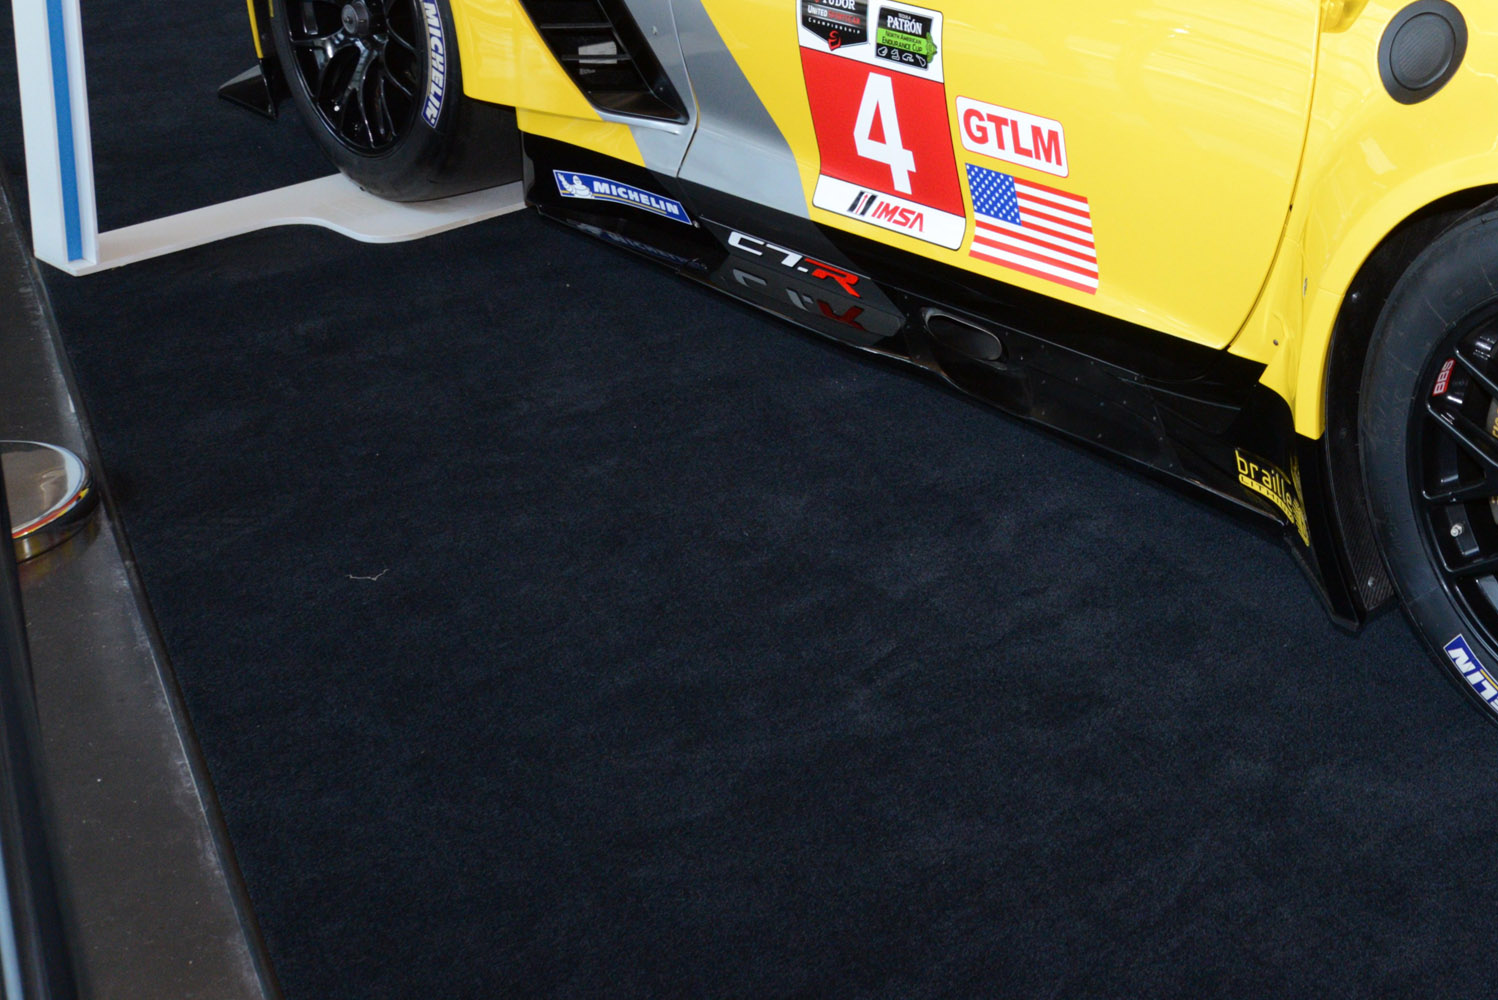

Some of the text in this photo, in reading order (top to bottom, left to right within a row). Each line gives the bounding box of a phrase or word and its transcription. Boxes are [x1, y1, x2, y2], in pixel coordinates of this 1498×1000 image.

[807, 4, 828, 17] UNITED
[808, 17, 861, 34] CHAMPIONSHIP
[887, 15, 923, 36] PATRÓN
[881, 36, 923, 52] ENDURANCE CUP
[423, 2, 445, 124] MICHELIN
[853, 71, 917, 195] 4
[962, 108, 1063, 167] GTLM
[593, 181, 679, 216] MICHELIN
[871, 201, 924, 232] IMSA
[1433, 359, 1455, 395] BBS
[1235, 449, 1293, 513] braille
